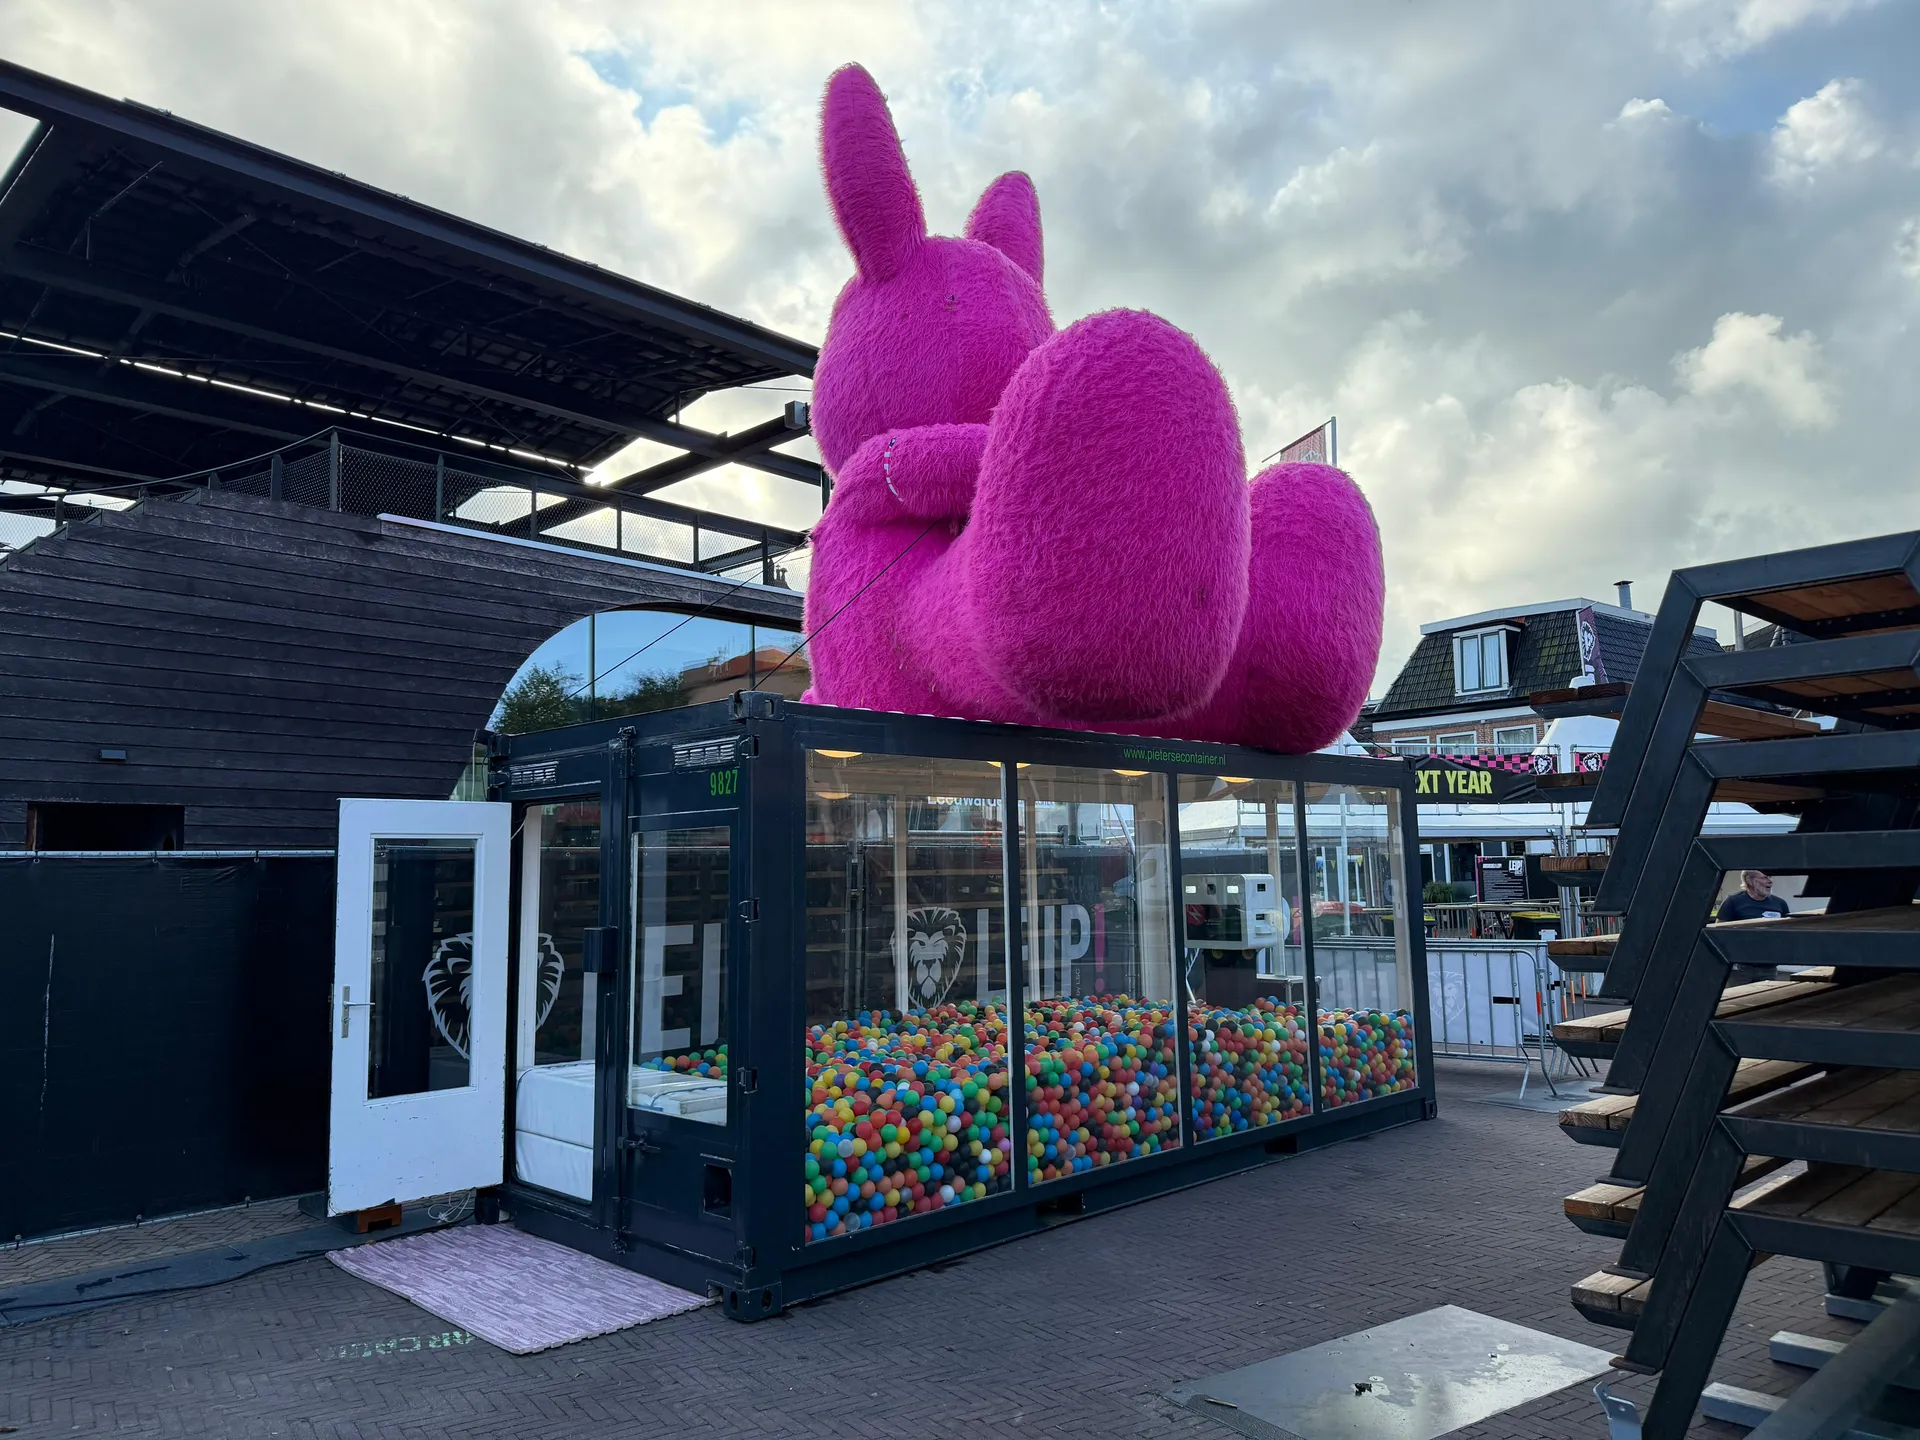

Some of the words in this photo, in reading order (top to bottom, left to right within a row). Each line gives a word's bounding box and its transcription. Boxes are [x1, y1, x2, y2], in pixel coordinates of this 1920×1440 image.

[1123, 748, 1226, 766] www.pietersecontainer.nl
[710, 769, 738, 796] 9827
[1445, 770, 1493, 794] YEAR
